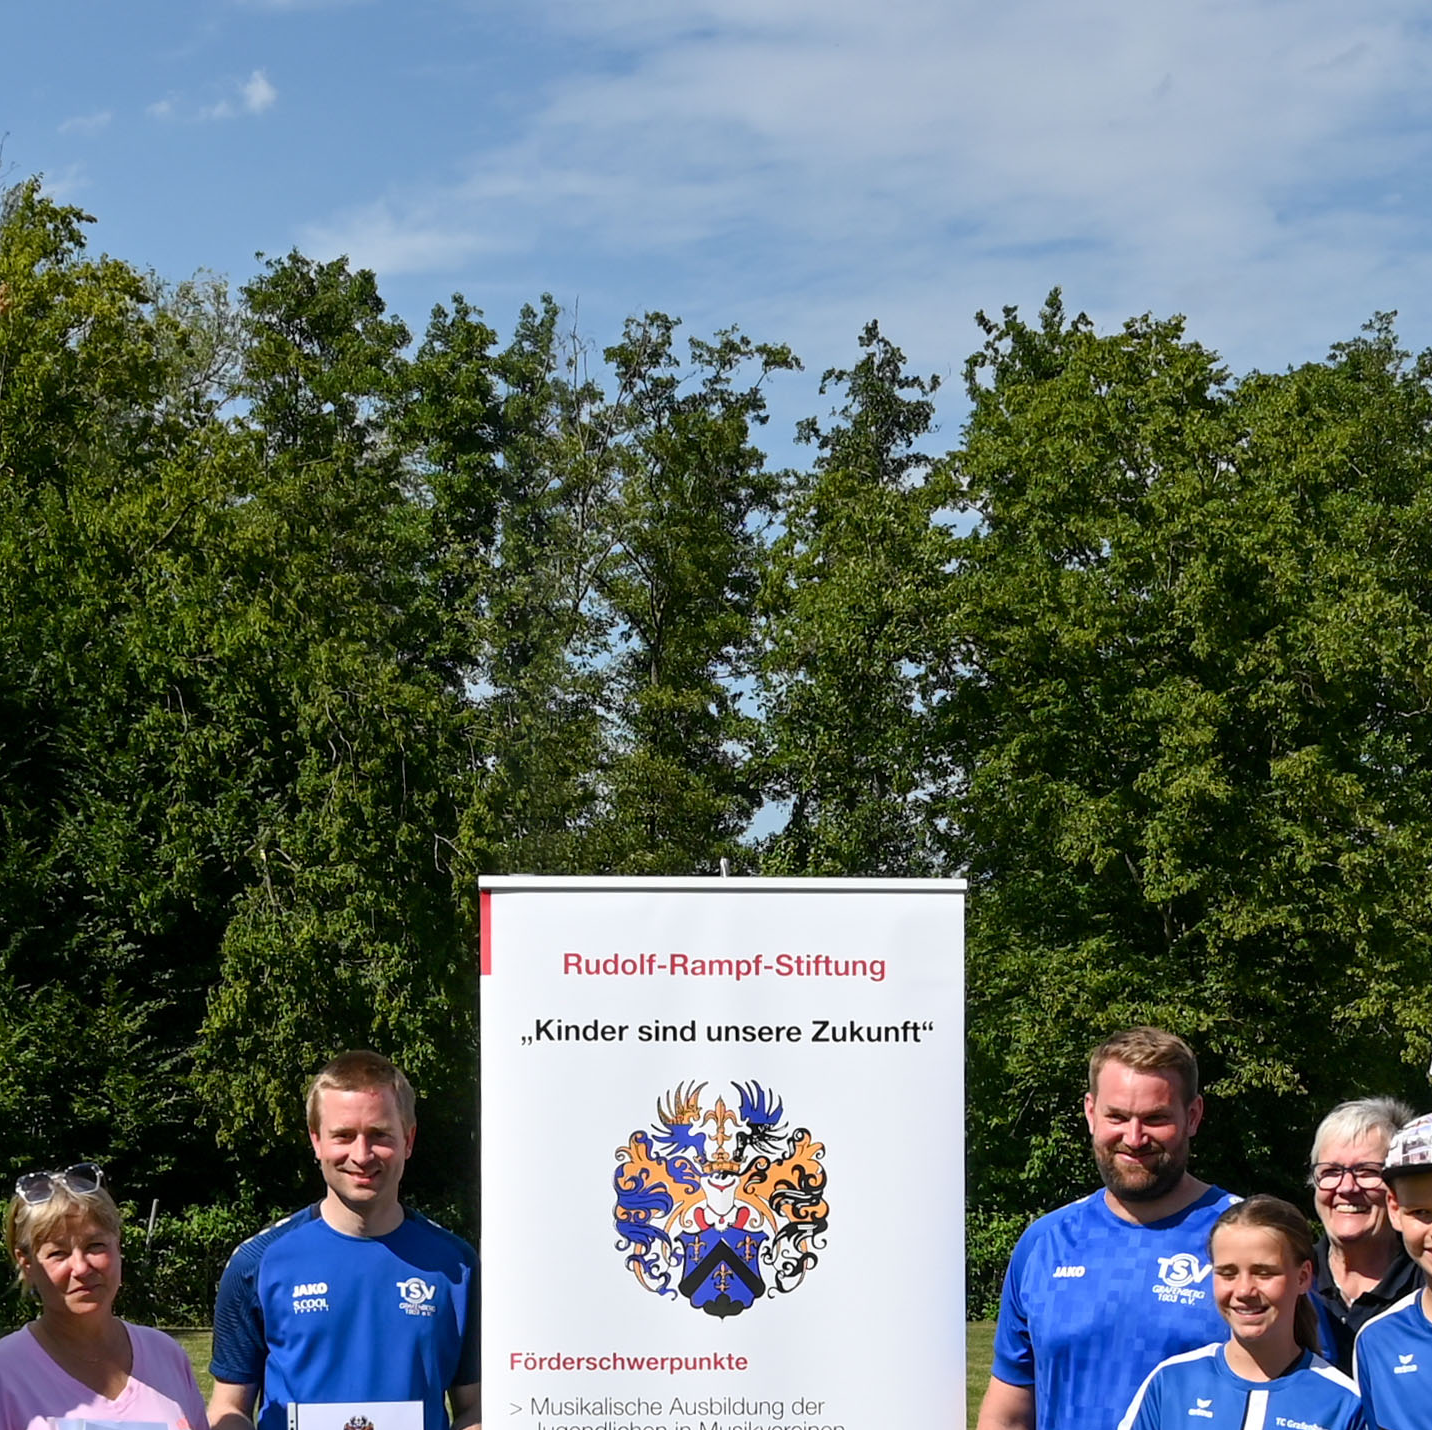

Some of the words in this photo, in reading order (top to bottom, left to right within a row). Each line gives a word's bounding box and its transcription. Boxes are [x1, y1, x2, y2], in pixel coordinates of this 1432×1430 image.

[562, 952, 886, 981] Rudolf-Rampf-Stiftung
[637, 1019, 697, 1042] sind
[706, 1022, 802, 1042] unsere
[1053, 1265, 1086, 1278] JAKO
[1157, 1256, 1213, 1284] TSV
[292, 1282, 328, 1298] JAKO
[396, 1281, 436, 1300] TSV
[509, 1352, 748, 1375] Förderschwerpunkte
[530, 1397, 663, 1417] Musikalische
[669, 1396, 784, 1420] Ausbildung
[790, 1396, 825, 1416] der
[1276, 1417, 1286, 1427] TC
